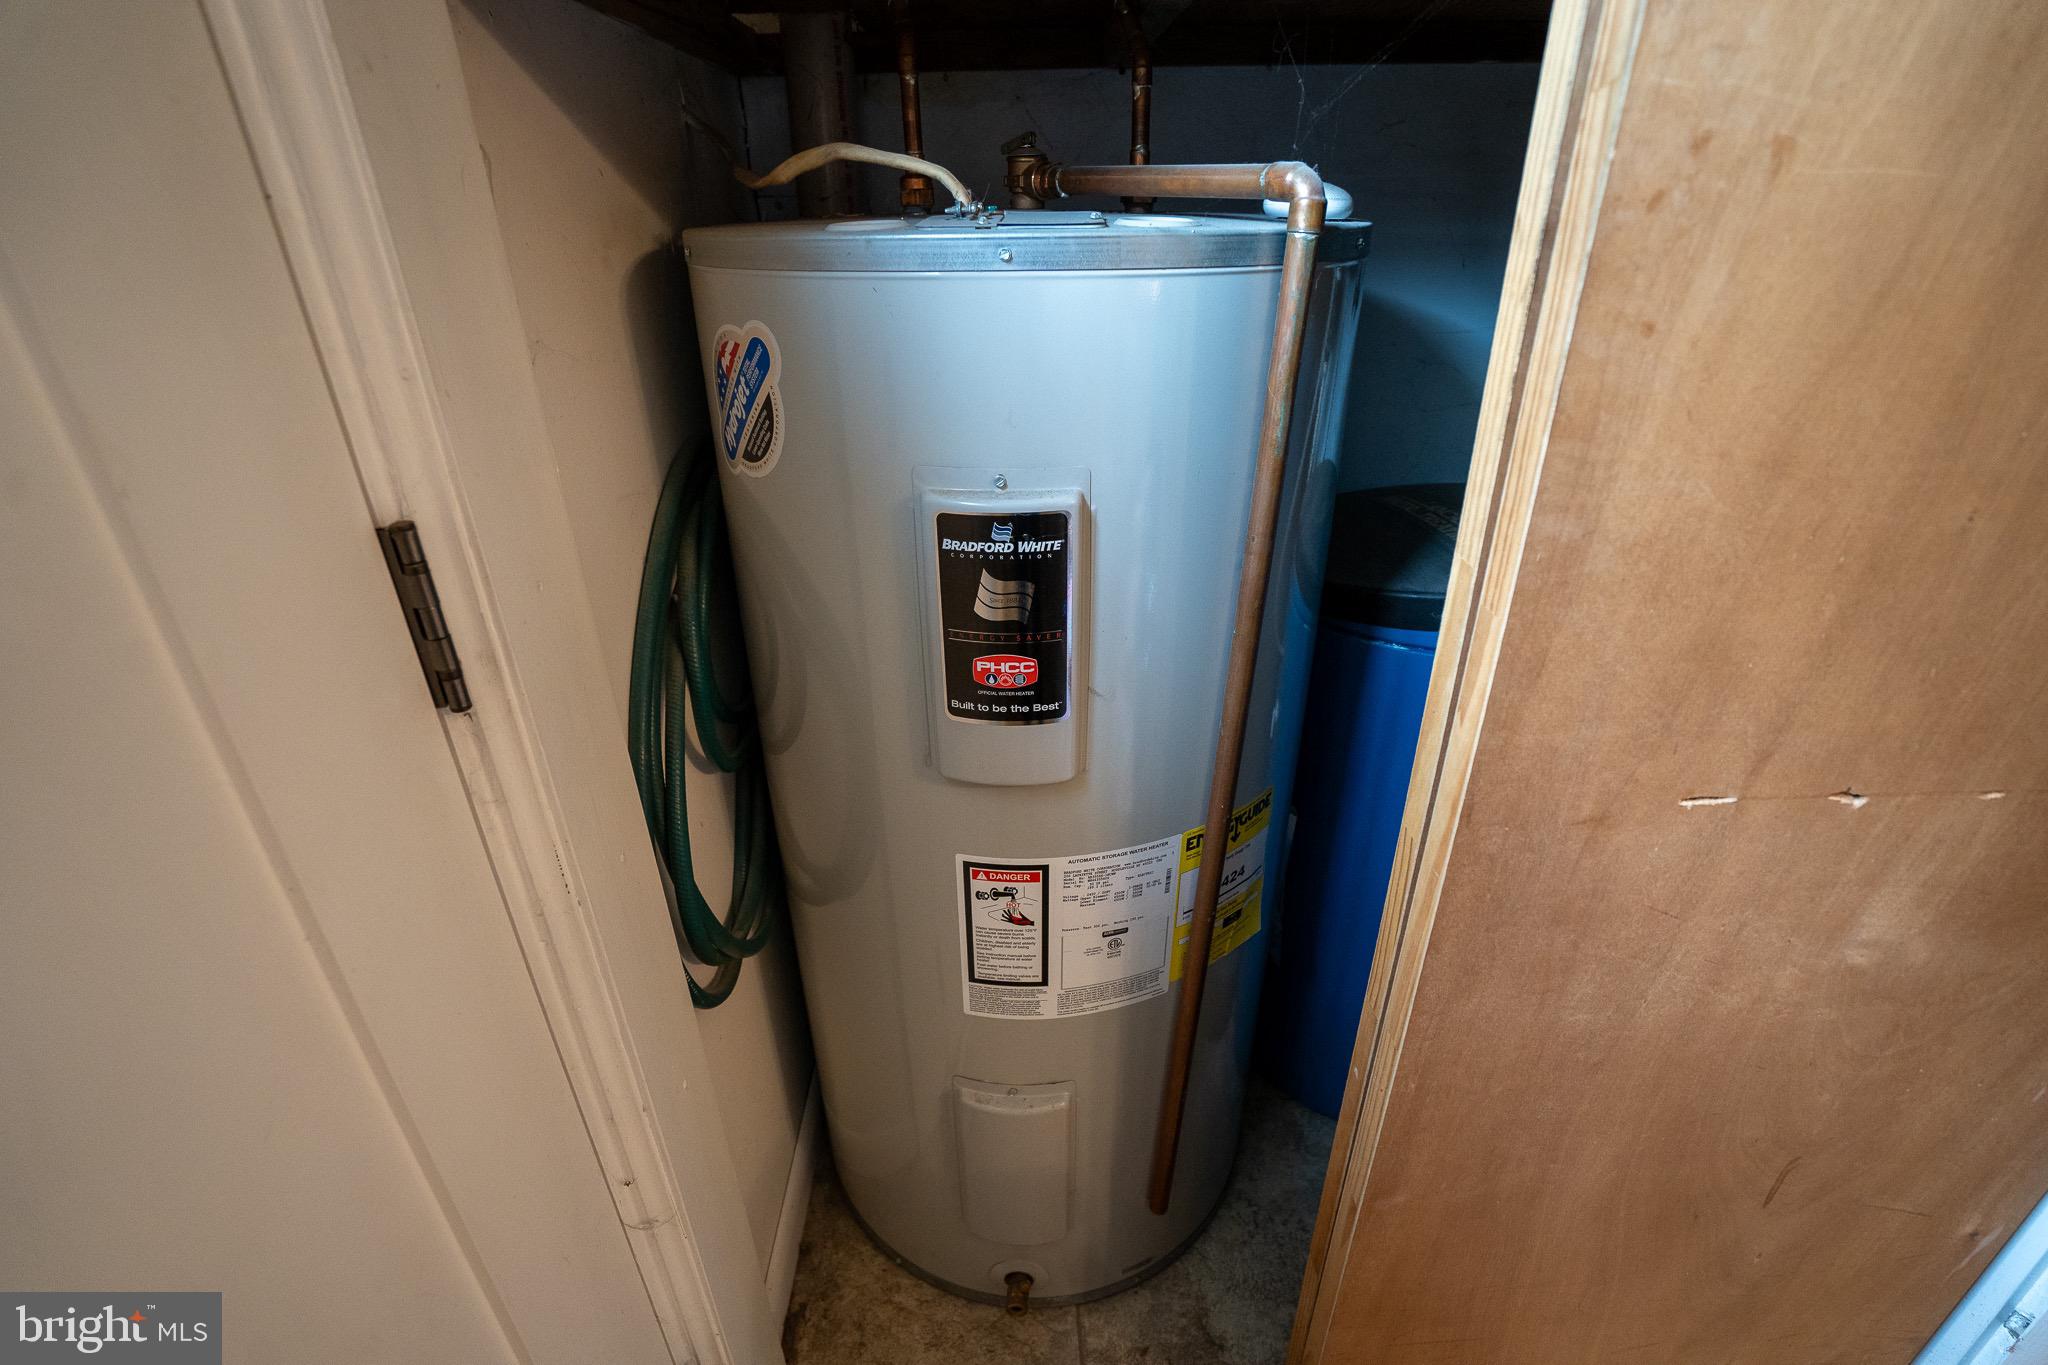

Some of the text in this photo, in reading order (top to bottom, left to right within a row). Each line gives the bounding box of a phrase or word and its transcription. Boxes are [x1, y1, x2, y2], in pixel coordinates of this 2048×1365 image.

[724, 374, 750, 451] Hydrojet
[942, 538, 1062, 553] BRADFORD WHITE
[1016, 632, 1061, 641] SAVER
[976, 661, 1035, 673] PHCC
[951, 699, 975, 711] Built
[978, 703, 989, 712] to
[992, 704, 1007, 713] be
[1010, 704, 1029, 713] the
[1068, 855, 1101, 864] AUTOMATIC
[1102, 851, 1128, 860] STORAGE
[1129, 846, 1148, 855] WATER
[1149, 841, 1169, 850] HEATER
[989, 873, 1031, 881] DANGER
